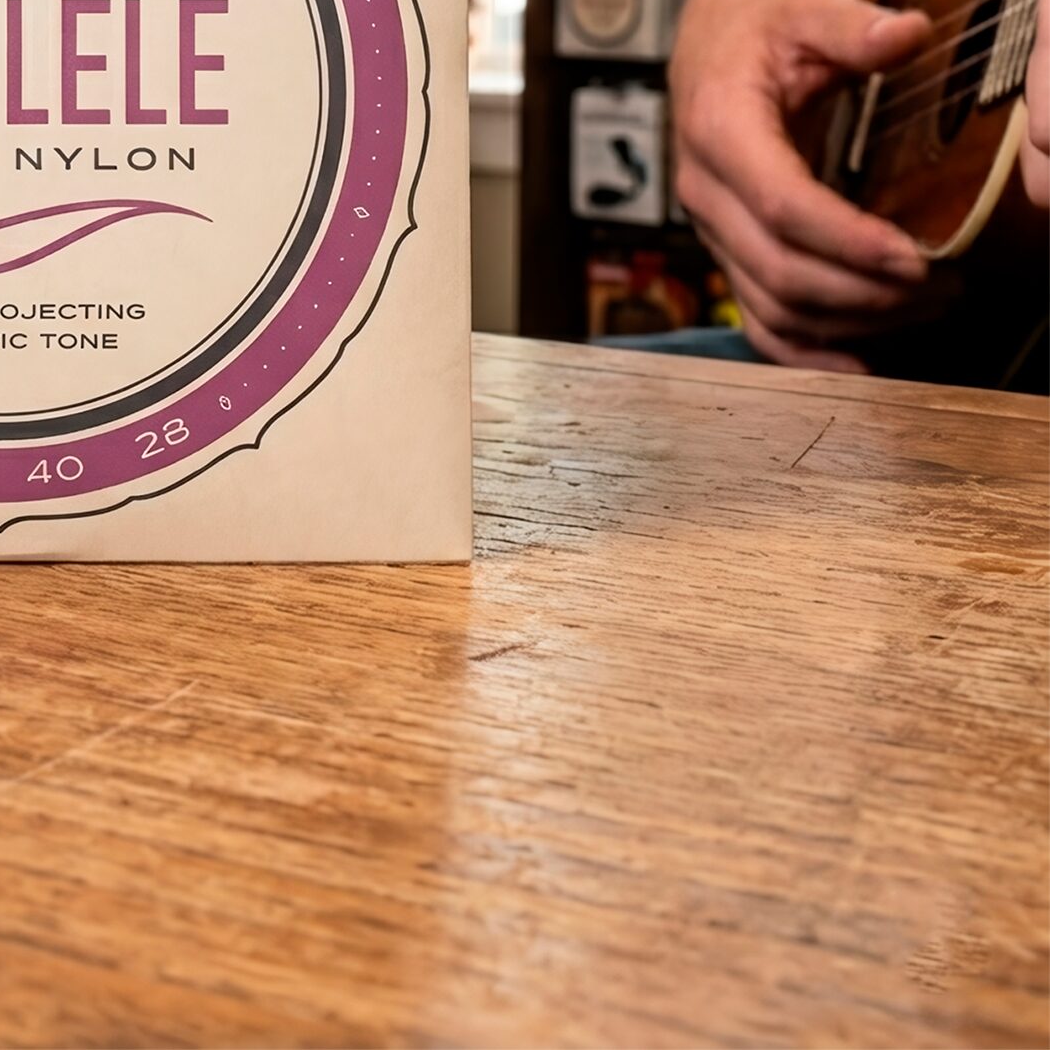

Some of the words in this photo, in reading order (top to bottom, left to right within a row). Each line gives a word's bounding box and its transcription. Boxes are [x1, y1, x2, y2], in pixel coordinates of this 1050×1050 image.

[14, 146, 196, 172] NYLON
[39, 332, 120, 351] TONE
[26, 454, 85, 484] 40
[133, 417, 191, 460] 28
